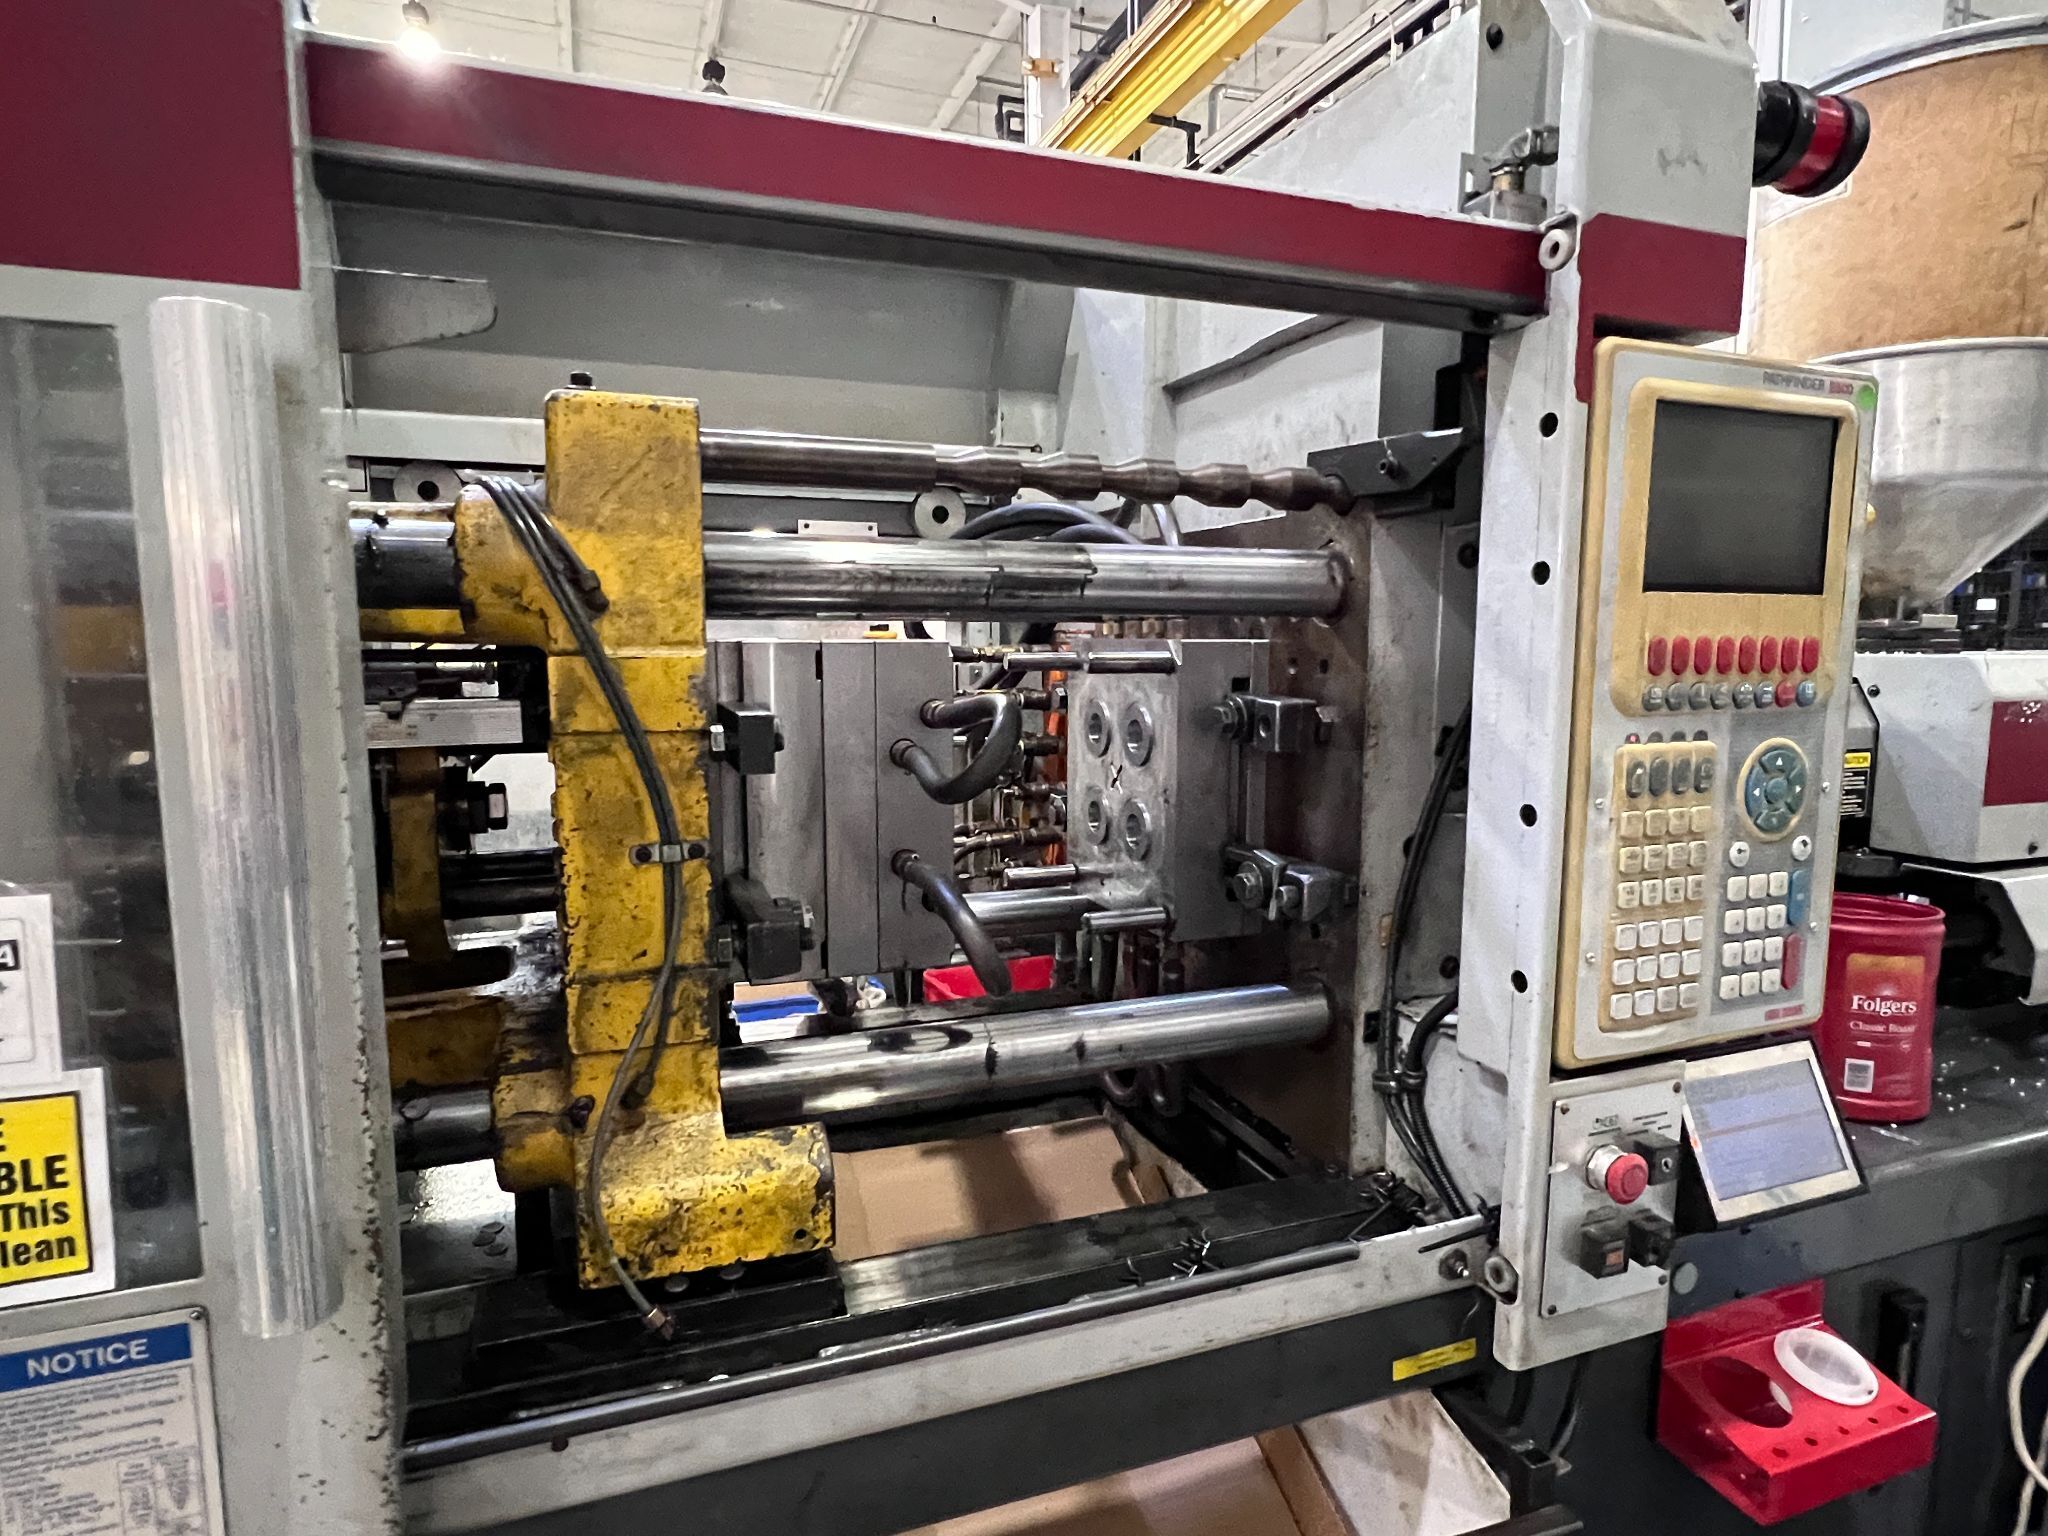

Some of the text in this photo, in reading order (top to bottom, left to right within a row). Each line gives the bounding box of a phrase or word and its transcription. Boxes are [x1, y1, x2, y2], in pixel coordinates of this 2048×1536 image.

[1851, 995, 1917, 1017] Folgers
[1849, 1021, 1887, 1032] Classic
[0, 1199, 70, 1232] This
[26, 1338, 150, 1380] NOTICE
